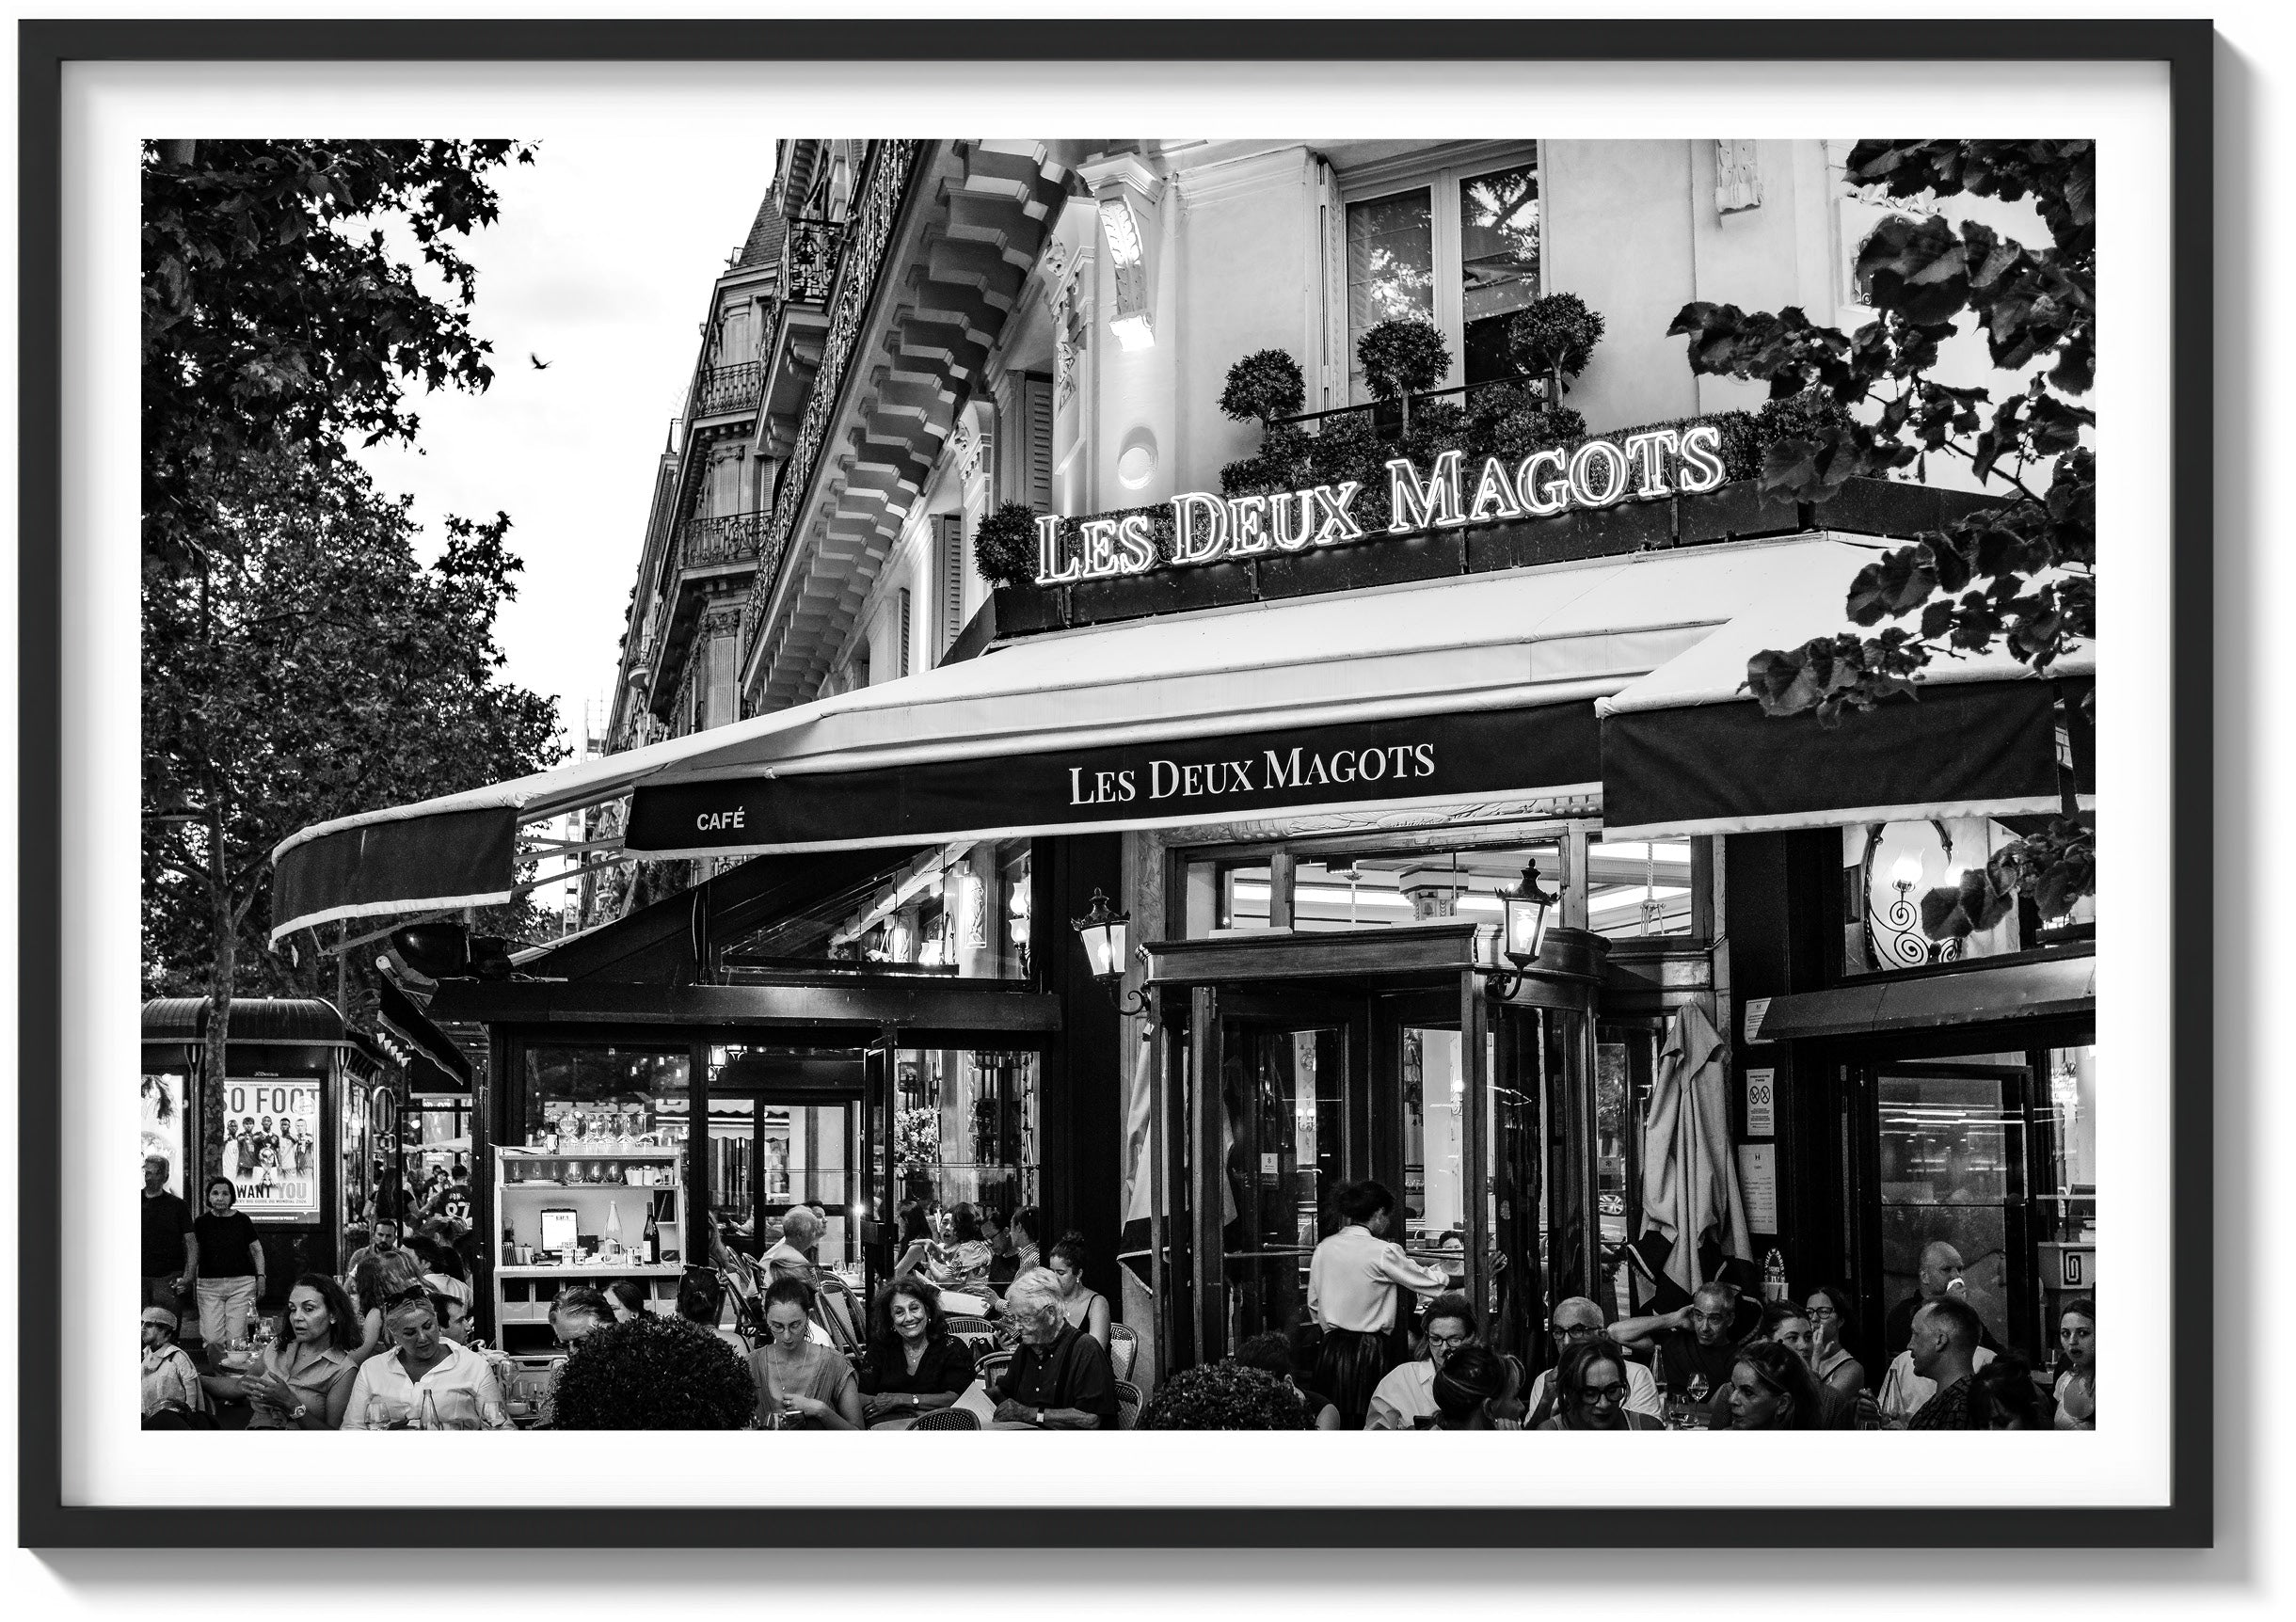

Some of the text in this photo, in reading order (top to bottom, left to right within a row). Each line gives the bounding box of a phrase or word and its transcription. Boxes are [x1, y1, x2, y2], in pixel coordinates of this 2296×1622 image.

[1035, 426, 1725, 584] LES DEUX MAGOTS
[1068, 743, 1435, 805] LES DEUX MAGOTS
[696, 805, 745, 831] CAFÉ
[276, 1182, 308, 1200] YOU
